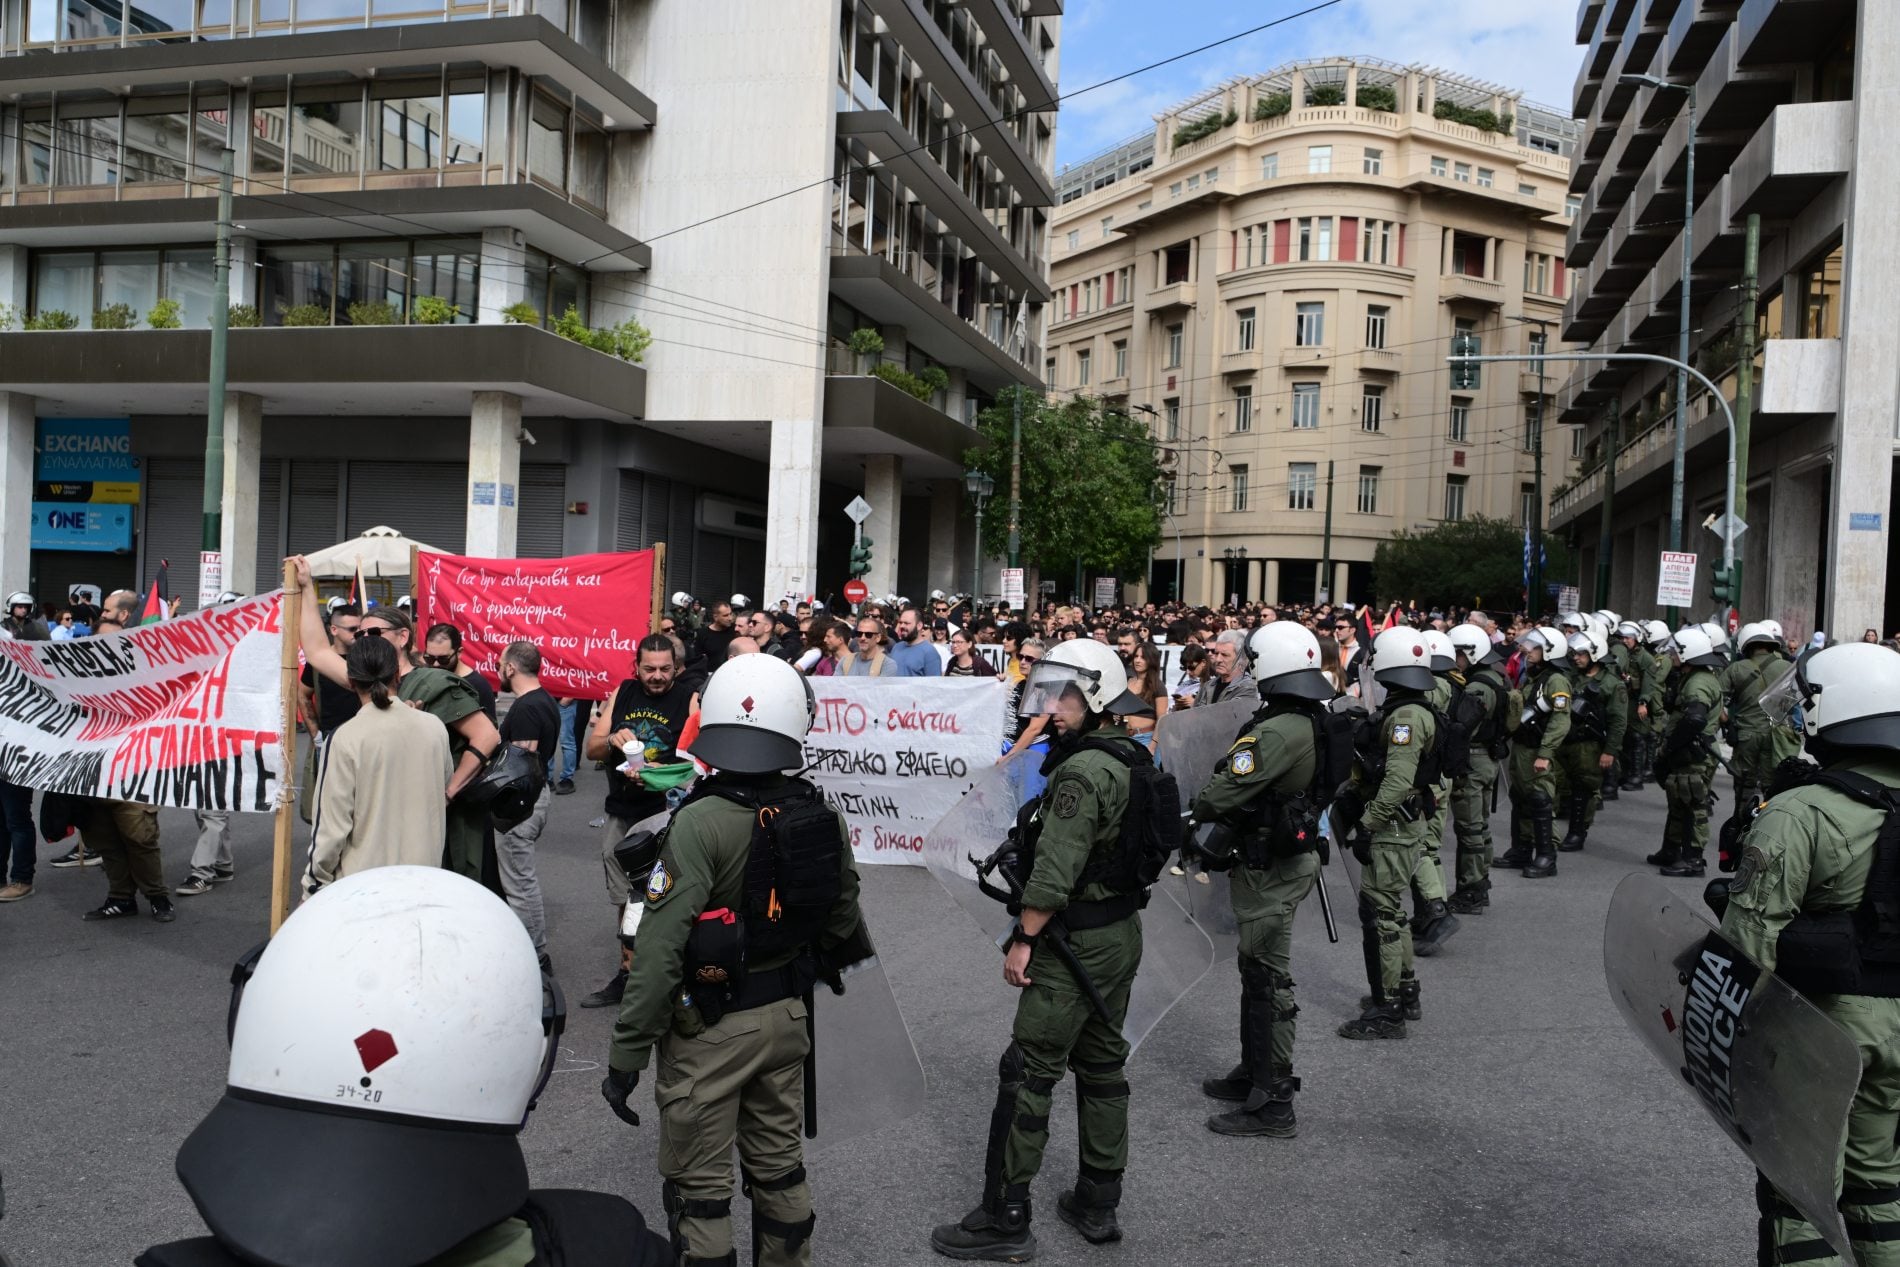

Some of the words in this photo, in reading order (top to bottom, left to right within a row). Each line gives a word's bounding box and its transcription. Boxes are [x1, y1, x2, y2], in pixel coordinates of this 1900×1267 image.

[43, 455, 129, 469] ΣΥΝΑΛΛΑΓΜΑ
[456, 566, 476, 585] Για
[480, 567, 497, 592] την
[576, 573, 601, 586] και
[473, 595, 483, 614] το
[551, 636, 578, 649] που
[583, 628, 637, 656] γίνεται
[541, 656, 609, 687] θεώρημα
[886, 701, 961, 734] ενάντια
[895, 746, 968, 779] ΣΦΑΓΕΙΟ
[336, 1084, 382, 1103] 34-20
